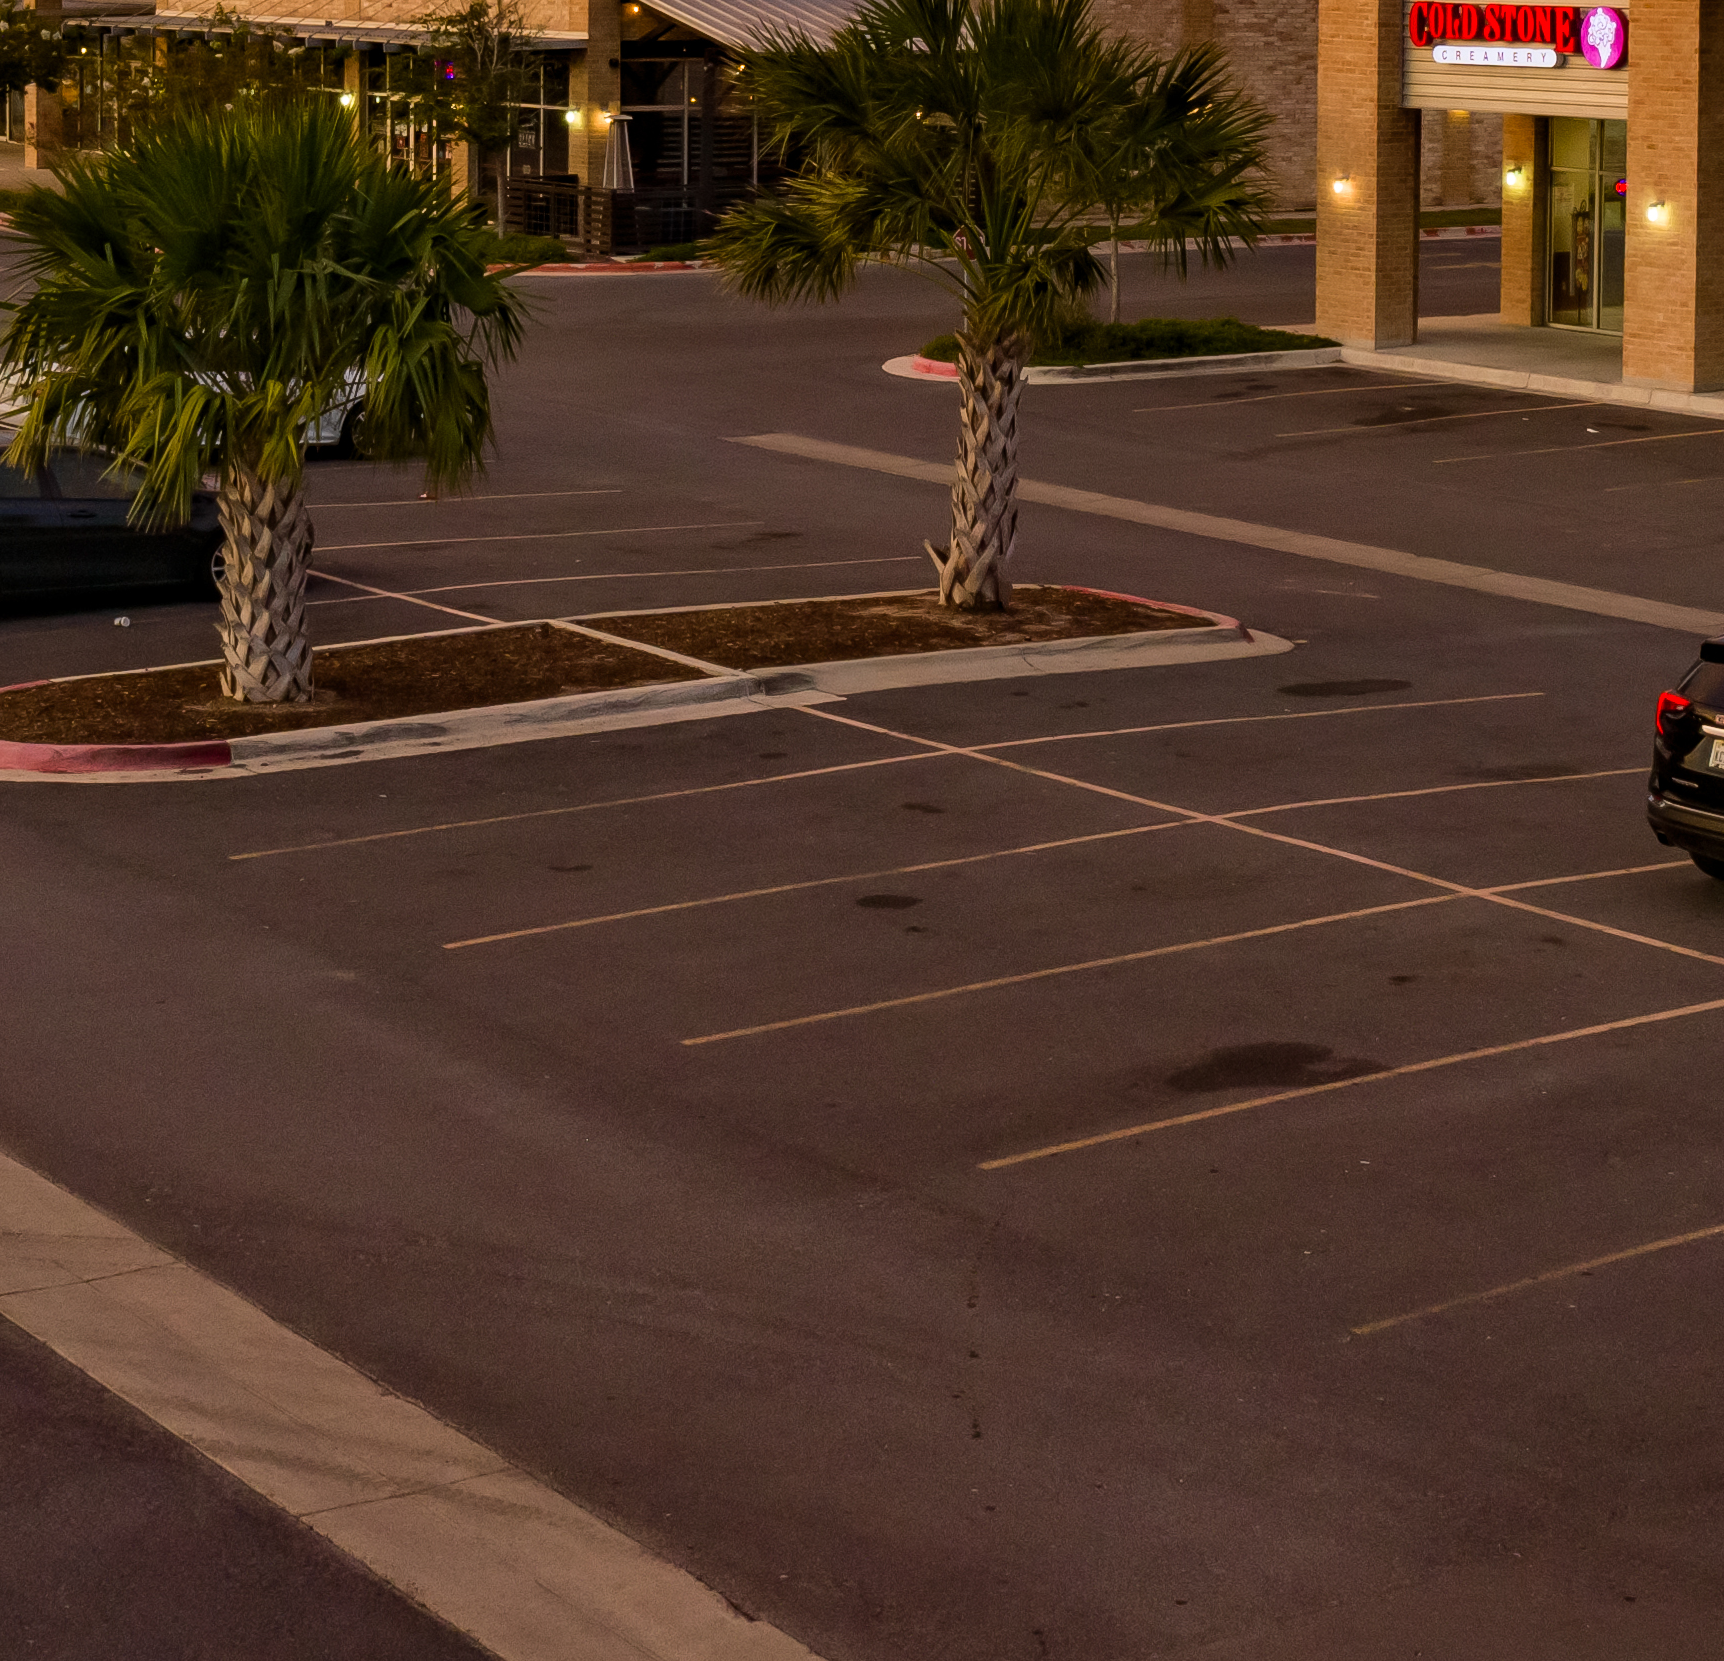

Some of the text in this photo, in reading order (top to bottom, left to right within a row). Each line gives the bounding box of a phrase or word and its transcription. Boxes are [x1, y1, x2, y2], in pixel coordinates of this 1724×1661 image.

[1408, 1, 1575, 53] COLD STONE
[1442, 50, 1547, 63] CREAMERY
